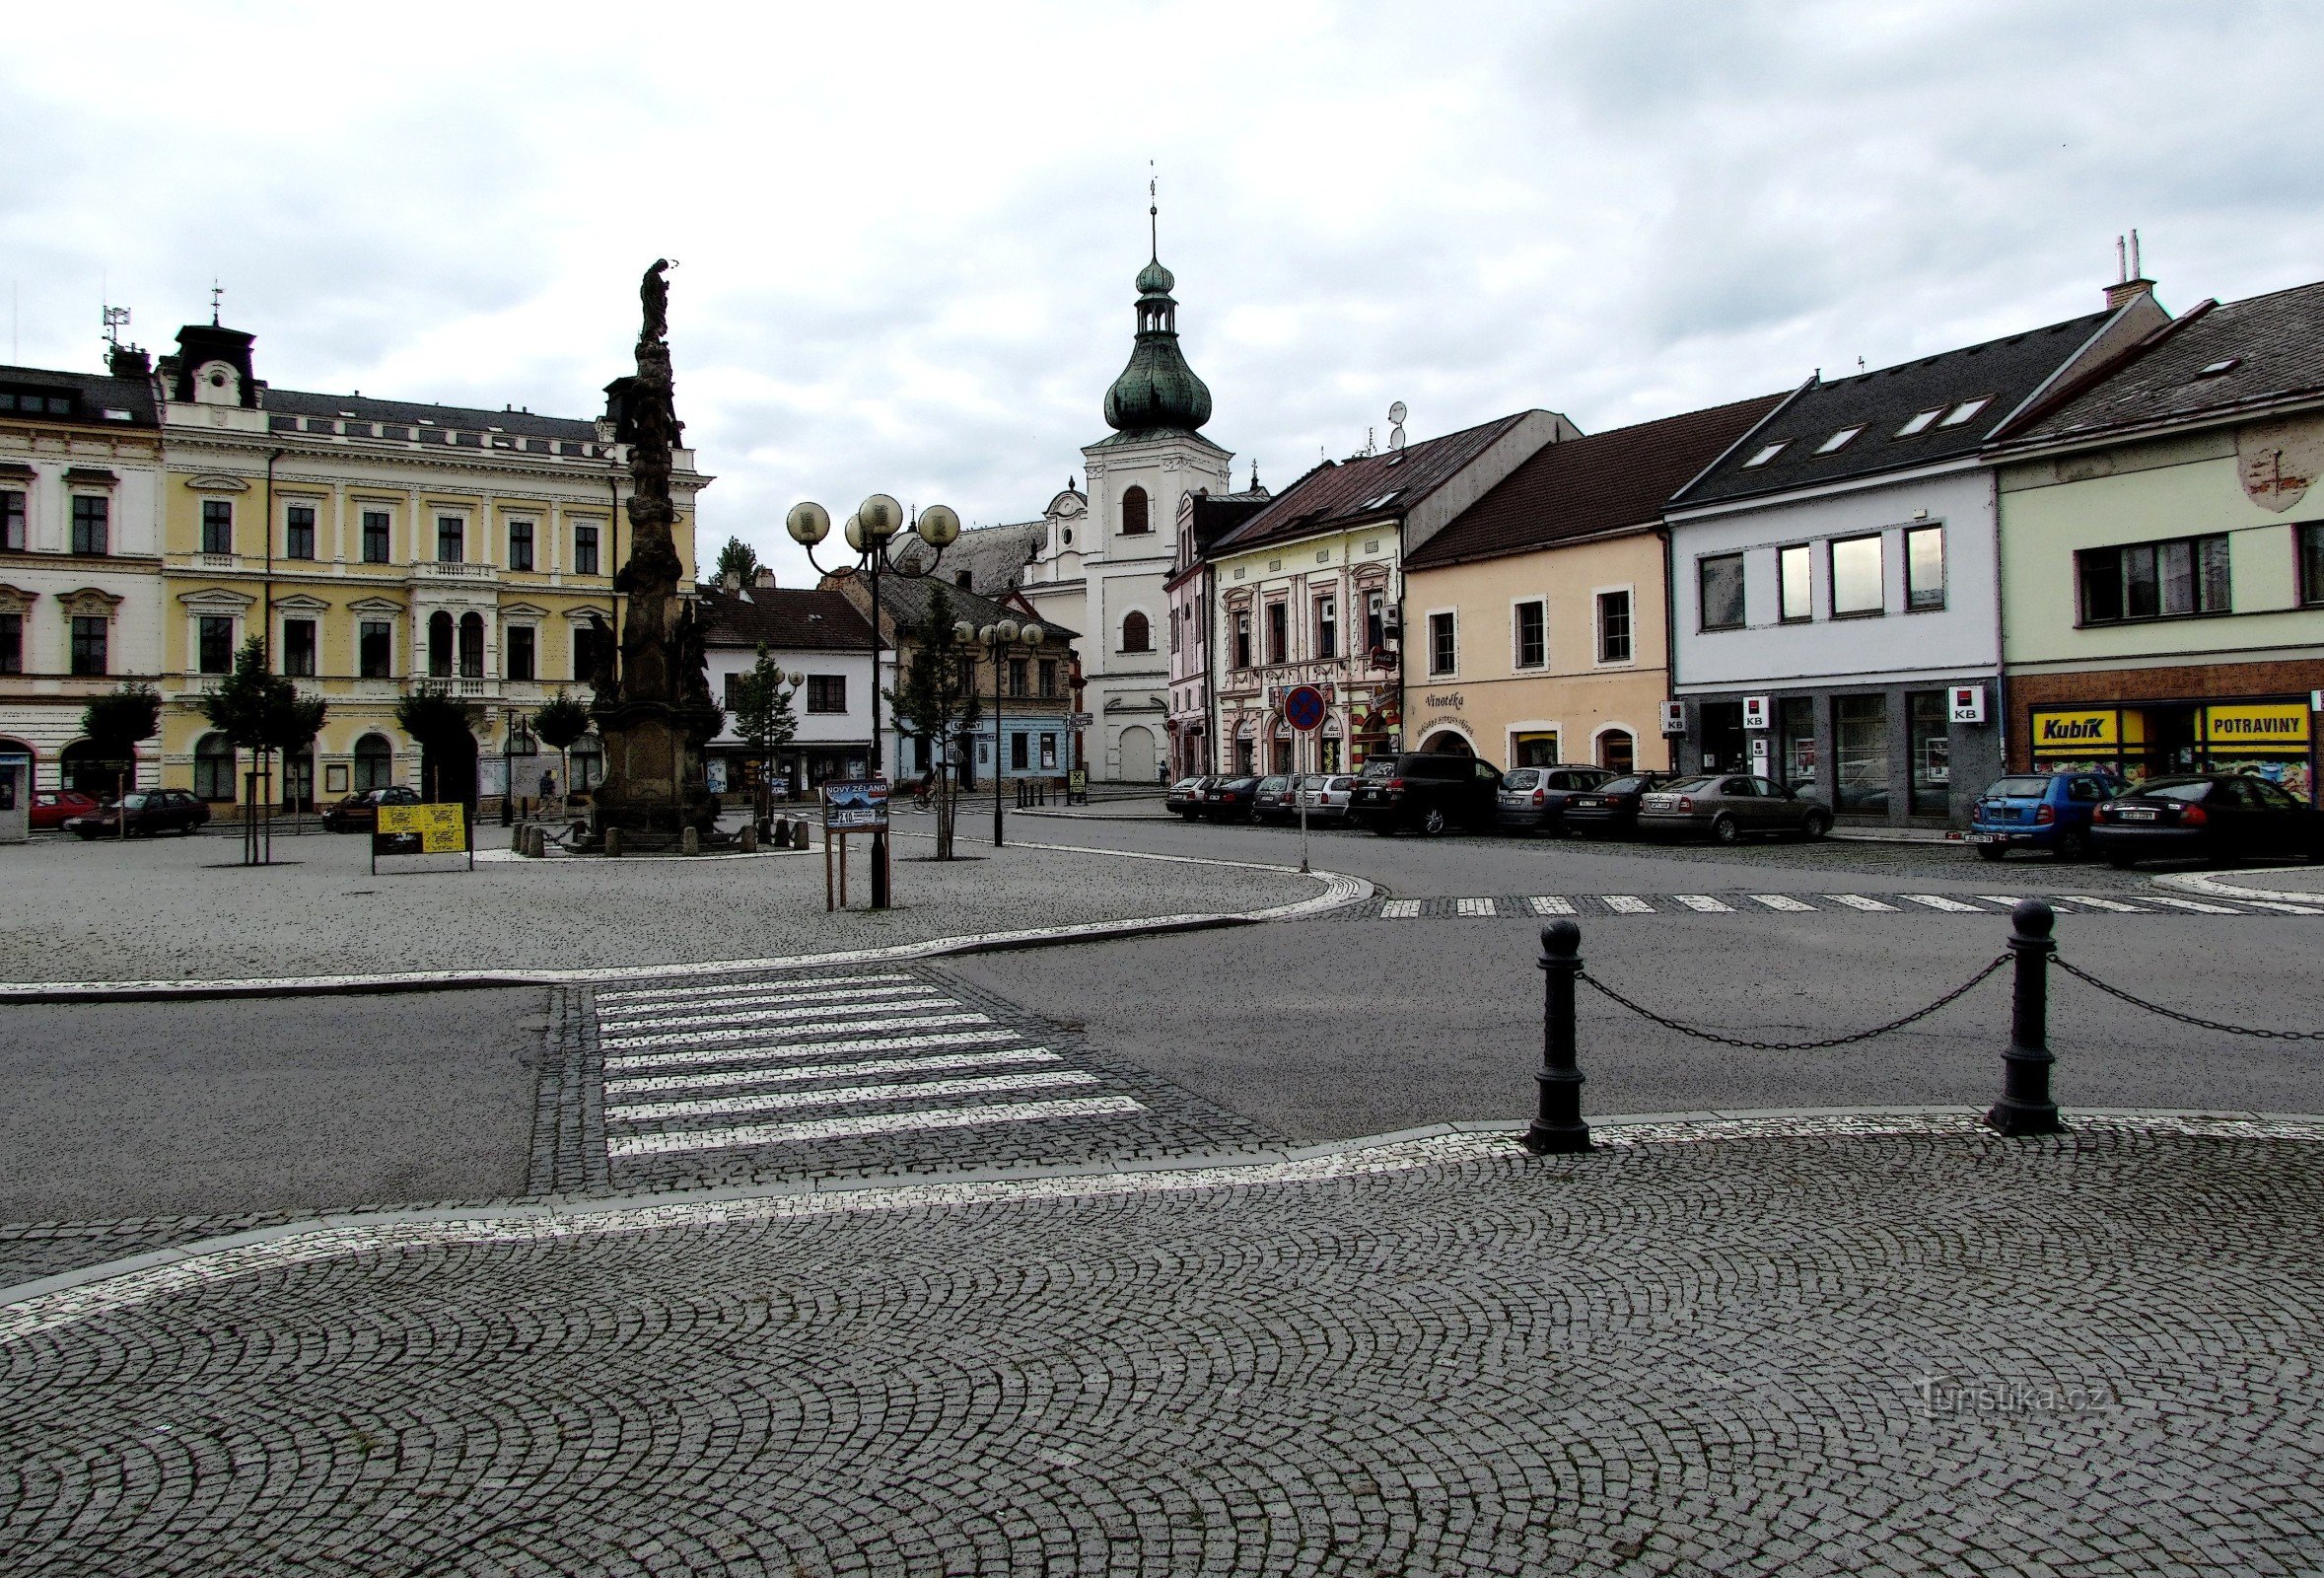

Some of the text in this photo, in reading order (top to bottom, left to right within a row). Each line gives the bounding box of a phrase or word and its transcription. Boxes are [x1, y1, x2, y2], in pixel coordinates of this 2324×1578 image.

[1954, 710, 1976, 719] KB
[1747, 717, 1763, 726] KB
[2214, 717, 2300, 734] POTRAVINY
